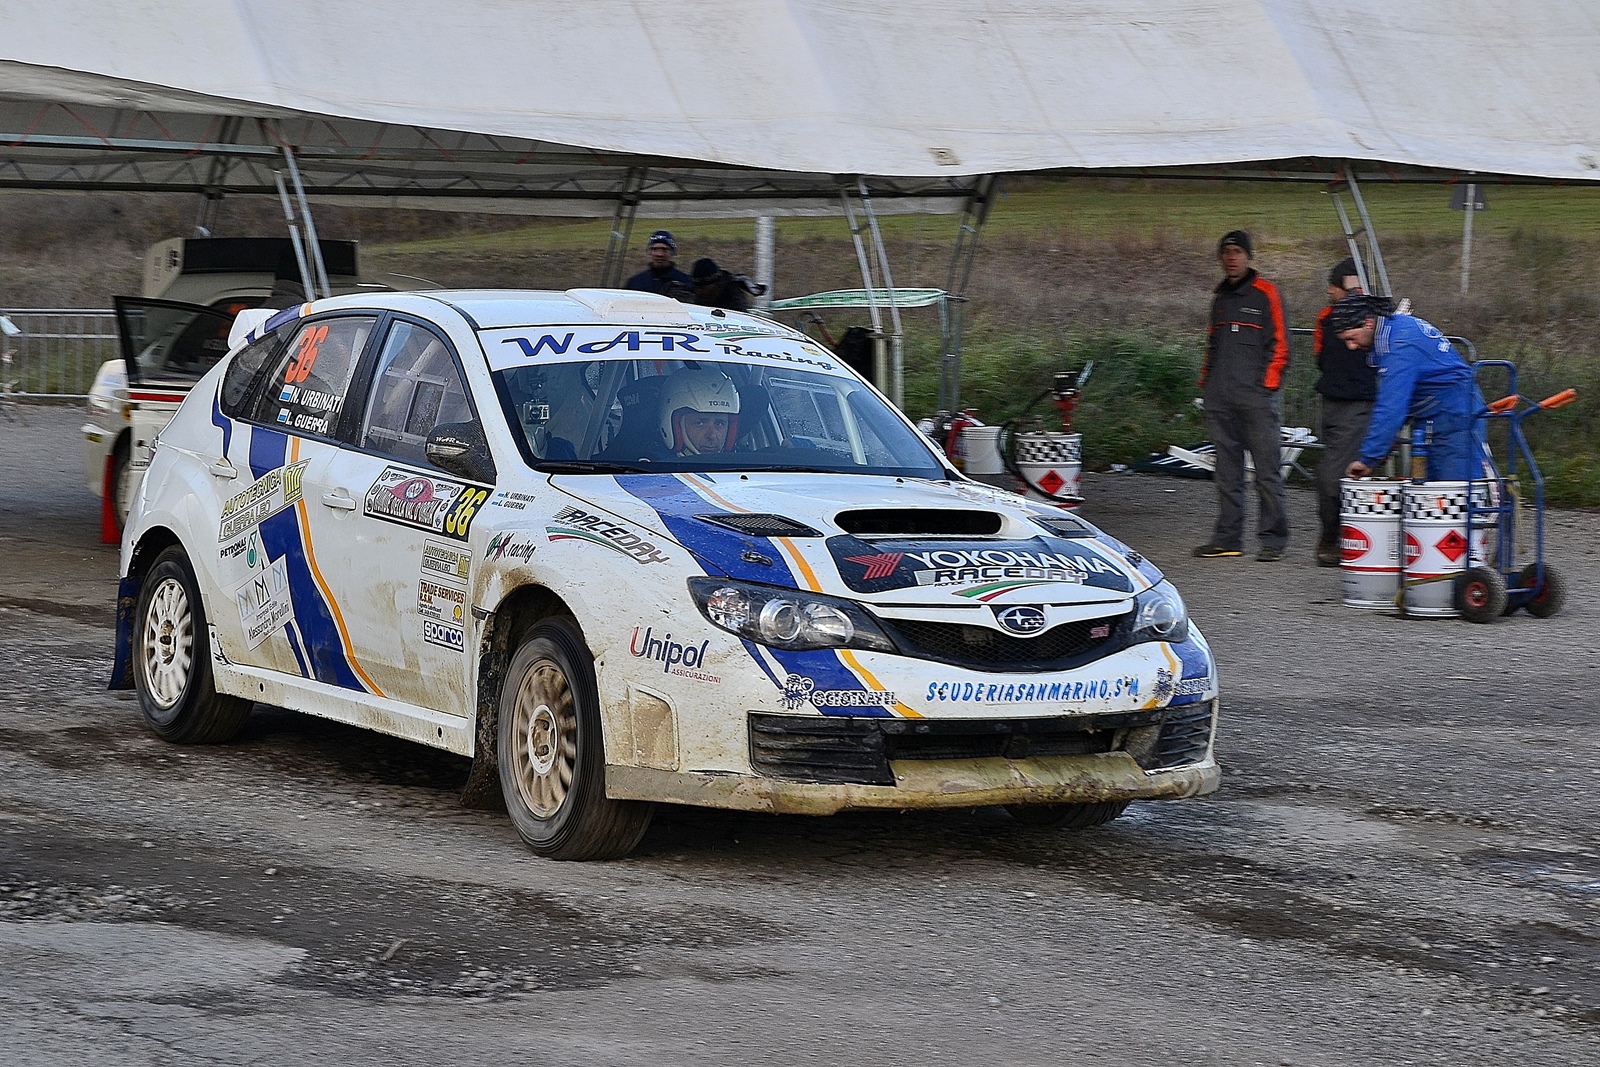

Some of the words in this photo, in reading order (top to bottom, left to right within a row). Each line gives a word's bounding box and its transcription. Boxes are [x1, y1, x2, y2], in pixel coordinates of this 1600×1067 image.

[285, 325, 330, 383] 36
[501, 331, 712, 358] WAR
[715, 343, 837, 370] Racing
[289, 387, 301, 404] N.
[300, 389, 346, 414] URBINATI
[285, 411, 294, 426] L.
[294, 413, 329, 434] GUERRA
[220, 469, 282, 519] AUTOTECNICA
[503, 501, 526, 510] GUERRA
[223, 507, 255, 537] GUERRA
[446, 487, 487, 536] 36
[220, 537, 247, 558] PETRONAS
[559, 507, 671, 565] RACEDAY
[424, 545, 459, 563] AUTOTECNICA
[908, 550, 1123, 577] YOKOHAMA
[934, 566, 1088, 584] RACEDAY
[420, 581, 437, 597] TRADE
[437, 586, 465, 604] SERVICES
[424, 621, 463, 646] sparco
[630, 626, 710, 673] Unipol
[671, 668, 721, 684] ASSICURAZIONI
